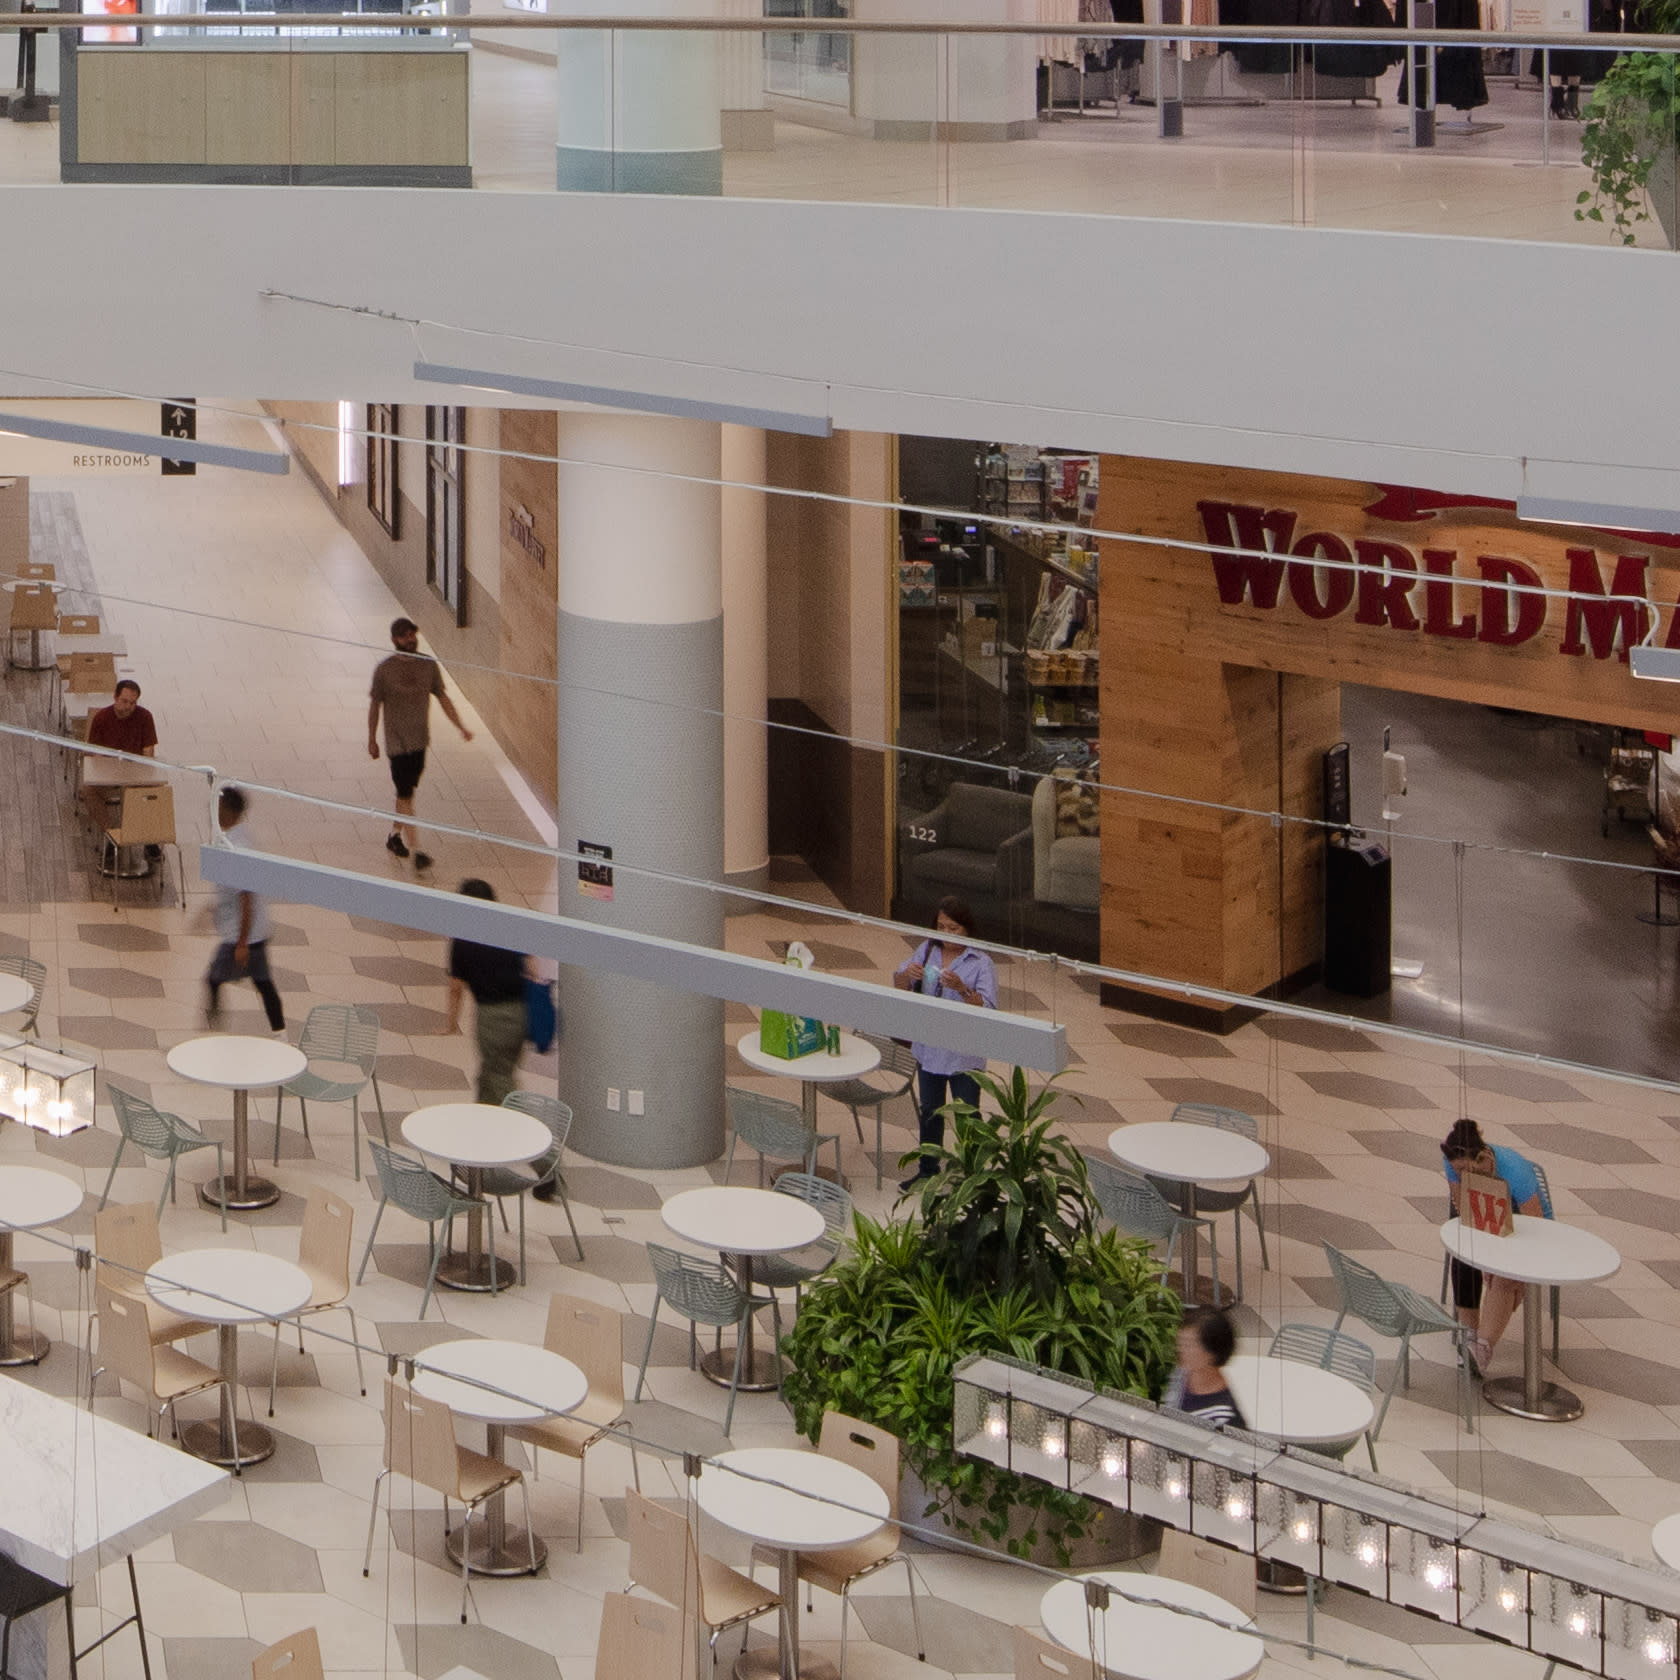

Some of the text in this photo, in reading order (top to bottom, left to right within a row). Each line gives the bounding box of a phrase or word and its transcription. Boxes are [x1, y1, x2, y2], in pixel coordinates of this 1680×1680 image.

[73, 454, 151, 468] RESTROOMS
[1195, 500, 1546, 647] WORLD
[908, 824, 938, 843] 122
